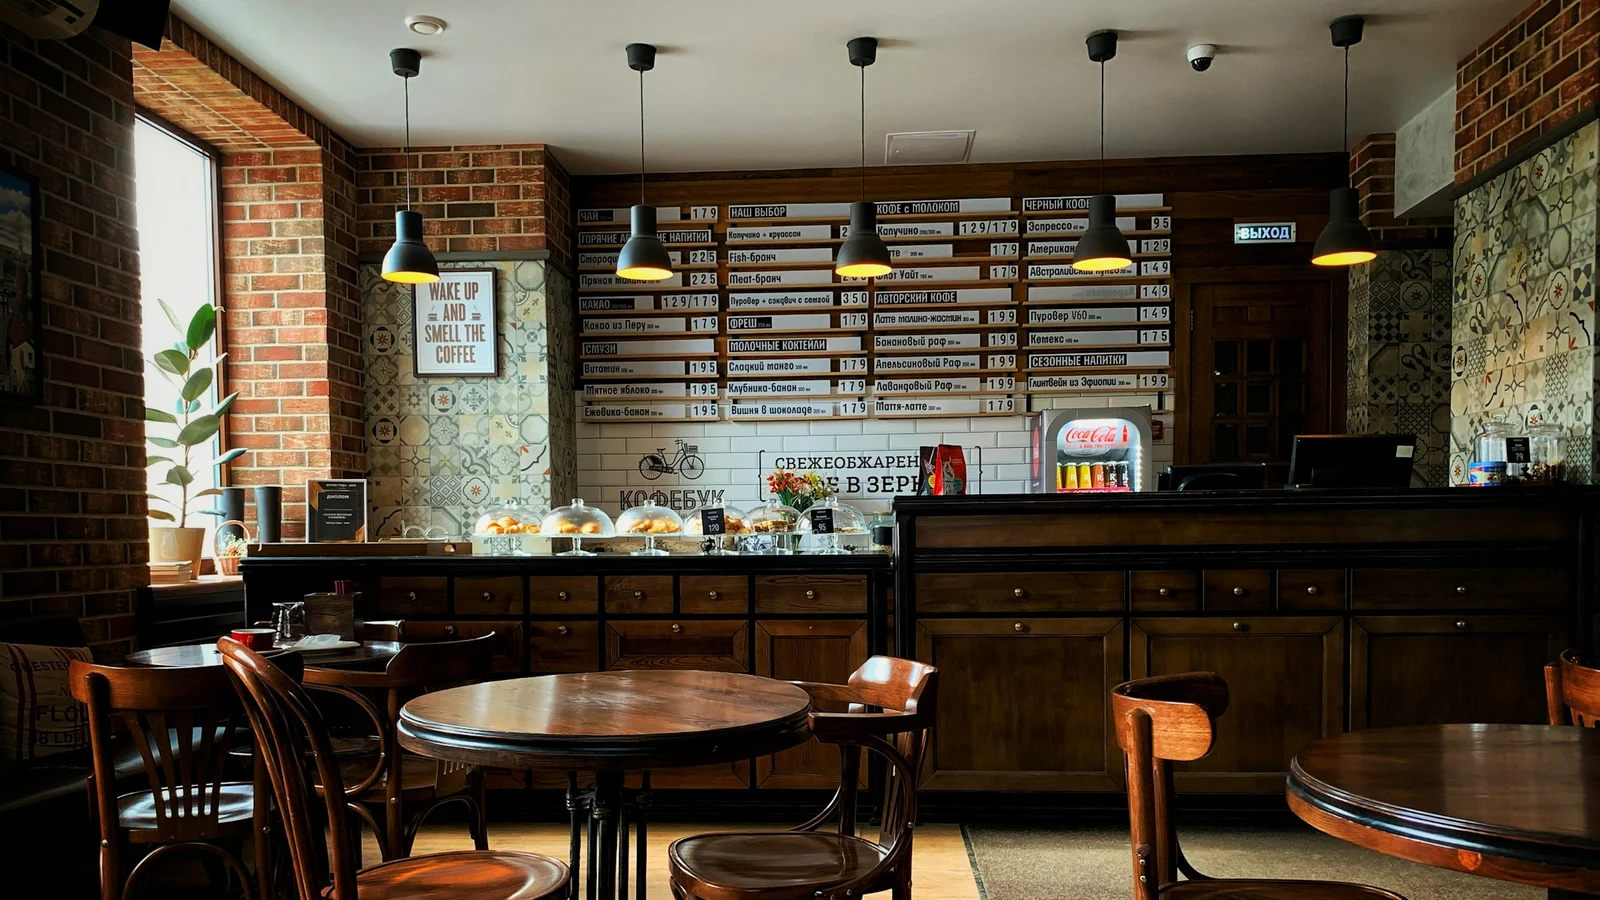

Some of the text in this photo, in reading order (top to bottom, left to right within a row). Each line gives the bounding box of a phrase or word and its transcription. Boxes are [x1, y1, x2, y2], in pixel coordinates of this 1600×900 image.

[876, 204, 902, 215] КОФЕ
[912, 202, 959, 213] МОЛОКОМ
[1026, 199, 1063, 210] ЧЕРНЫЙ
[581, 210, 598, 221] ЧАЙ
[693, 207, 717, 219] 179
[731, 207, 786, 218] НАШ ВЫБОР
[877, 226, 919, 237] Капучино
[962, 220, 1017, 234] 129/179
[1028, 221, 1072, 233] Эспрессо
[1153, 217, 1169, 228] 95
[581, 234, 617, 244] ГОРЯЧИЕ
[669, 232, 708, 243] НАПИТКИ
[728, 231, 760, 240] Капучино
[769, 231, 801, 240] круассан
[1240, 226, 1289, 239] ВЫХОД
[992, 243, 1017, 255] 179
[1030, 240, 1169, 255] Американ 129
[580, 252, 715, 265] Смороди 225
[729, 252, 776, 263] Fish-бранч
[900, 269, 919, 279] Уайт
[992, 266, 1017, 278] 179
[1143, 262, 1168, 273] 149
[581, 276, 612, 287] Пряная
[692, 273, 715, 285] 225
[729, 273, 781, 285] Meat-бранч
[429, 282, 479, 301] WAKE UP
[1143, 285, 1168, 297] 149
[582, 300, 610, 310] КАКАО
[664, 295, 717, 308] 129/179
[730, 297, 759, 306] Пуровер
[768, 296, 797, 306] сэндвич
[843, 292, 867, 304] 350
[877, 292, 956, 304] АВТОРСКИЙ КОФЕ
[443, 303, 466, 322] AND
[875, 314, 896, 324] Латте
[898, 314, 961, 323] малина-жасмин
[990, 311, 1015, 322] 199
[1030, 311, 1069, 323] Пуровер
[1072, 310, 1088, 320] V60
[1143, 307, 1168, 319] 149
[584, 320, 610, 330] Какао
[625, 320, 646, 331] Перу
[693, 317, 716, 329] 179
[730, 318, 757, 329] ФРЕШ
[842, 314, 866, 325] 179
[424, 324, 486, 343] SMELL THE
[1030, 334, 1064, 344] Кемекс
[1143, 330, 1168, 342] 175
[730, 339, 826, 351] МОЛОЧНЫЕ КОКТЕЙЛИ
[876, 337, 926, 346] Банановый
[928, 338, 946, 348] раф
[991, 334, 1015, 345] 199
[435, 345, 476, 364] COFFEE
[585, 344, 616, 354] СМУЗИ
[584, 362, 715, 373] Витамин 195
[729, 361, 764, 373] Сладкий
[767, 362, 794, 371] манго
[842, 359, 866, 370] 179
[876, 358, 940, 369] Апельсиновый
[943, 358, 961, 369] Раф
[990, 355, 1015, 367] 199
[1032, 355, 1125, 367] СЕЗОННЫЕ НАПИТКИ
[728, 382, 797, 394] Клубника-банан
[841, 380, 864, 391] 179
[876, 381, 932, 393] Лавандовый
[934, 380, 953, 391] Раф
[989, 378, 1013, 389] 199
[1029, 377, 1067, 388] Глинтвейн
[1070, 379, 1079, 387] из
[1081, 377, 1116, 388] Эфиопии
[1143, 375, 1167, 386] 199
[586, 384, 716, 395] Мятное яблоко 195
[584, 405, 717, 416] Ежевика-банан 195
[731, 406, 759, 415] Вишня
[769, 405, 812, 416] шоколаде
[843, 402, 866, 414] 179
[988, 400, 1013, 411] 179
[1066, 425, 1118, 443] Coca-Cola
[775, 455, 920, 470] СВЕЖЕОБЖАРЕН
[1515, 452, 1524, 461] 79
[846, 476, 860, 493] В
[620, 489, 725, 510] КОФЕБУК
[708, 523, 720, 532] 120
[818, 523, 827, 531] 95
